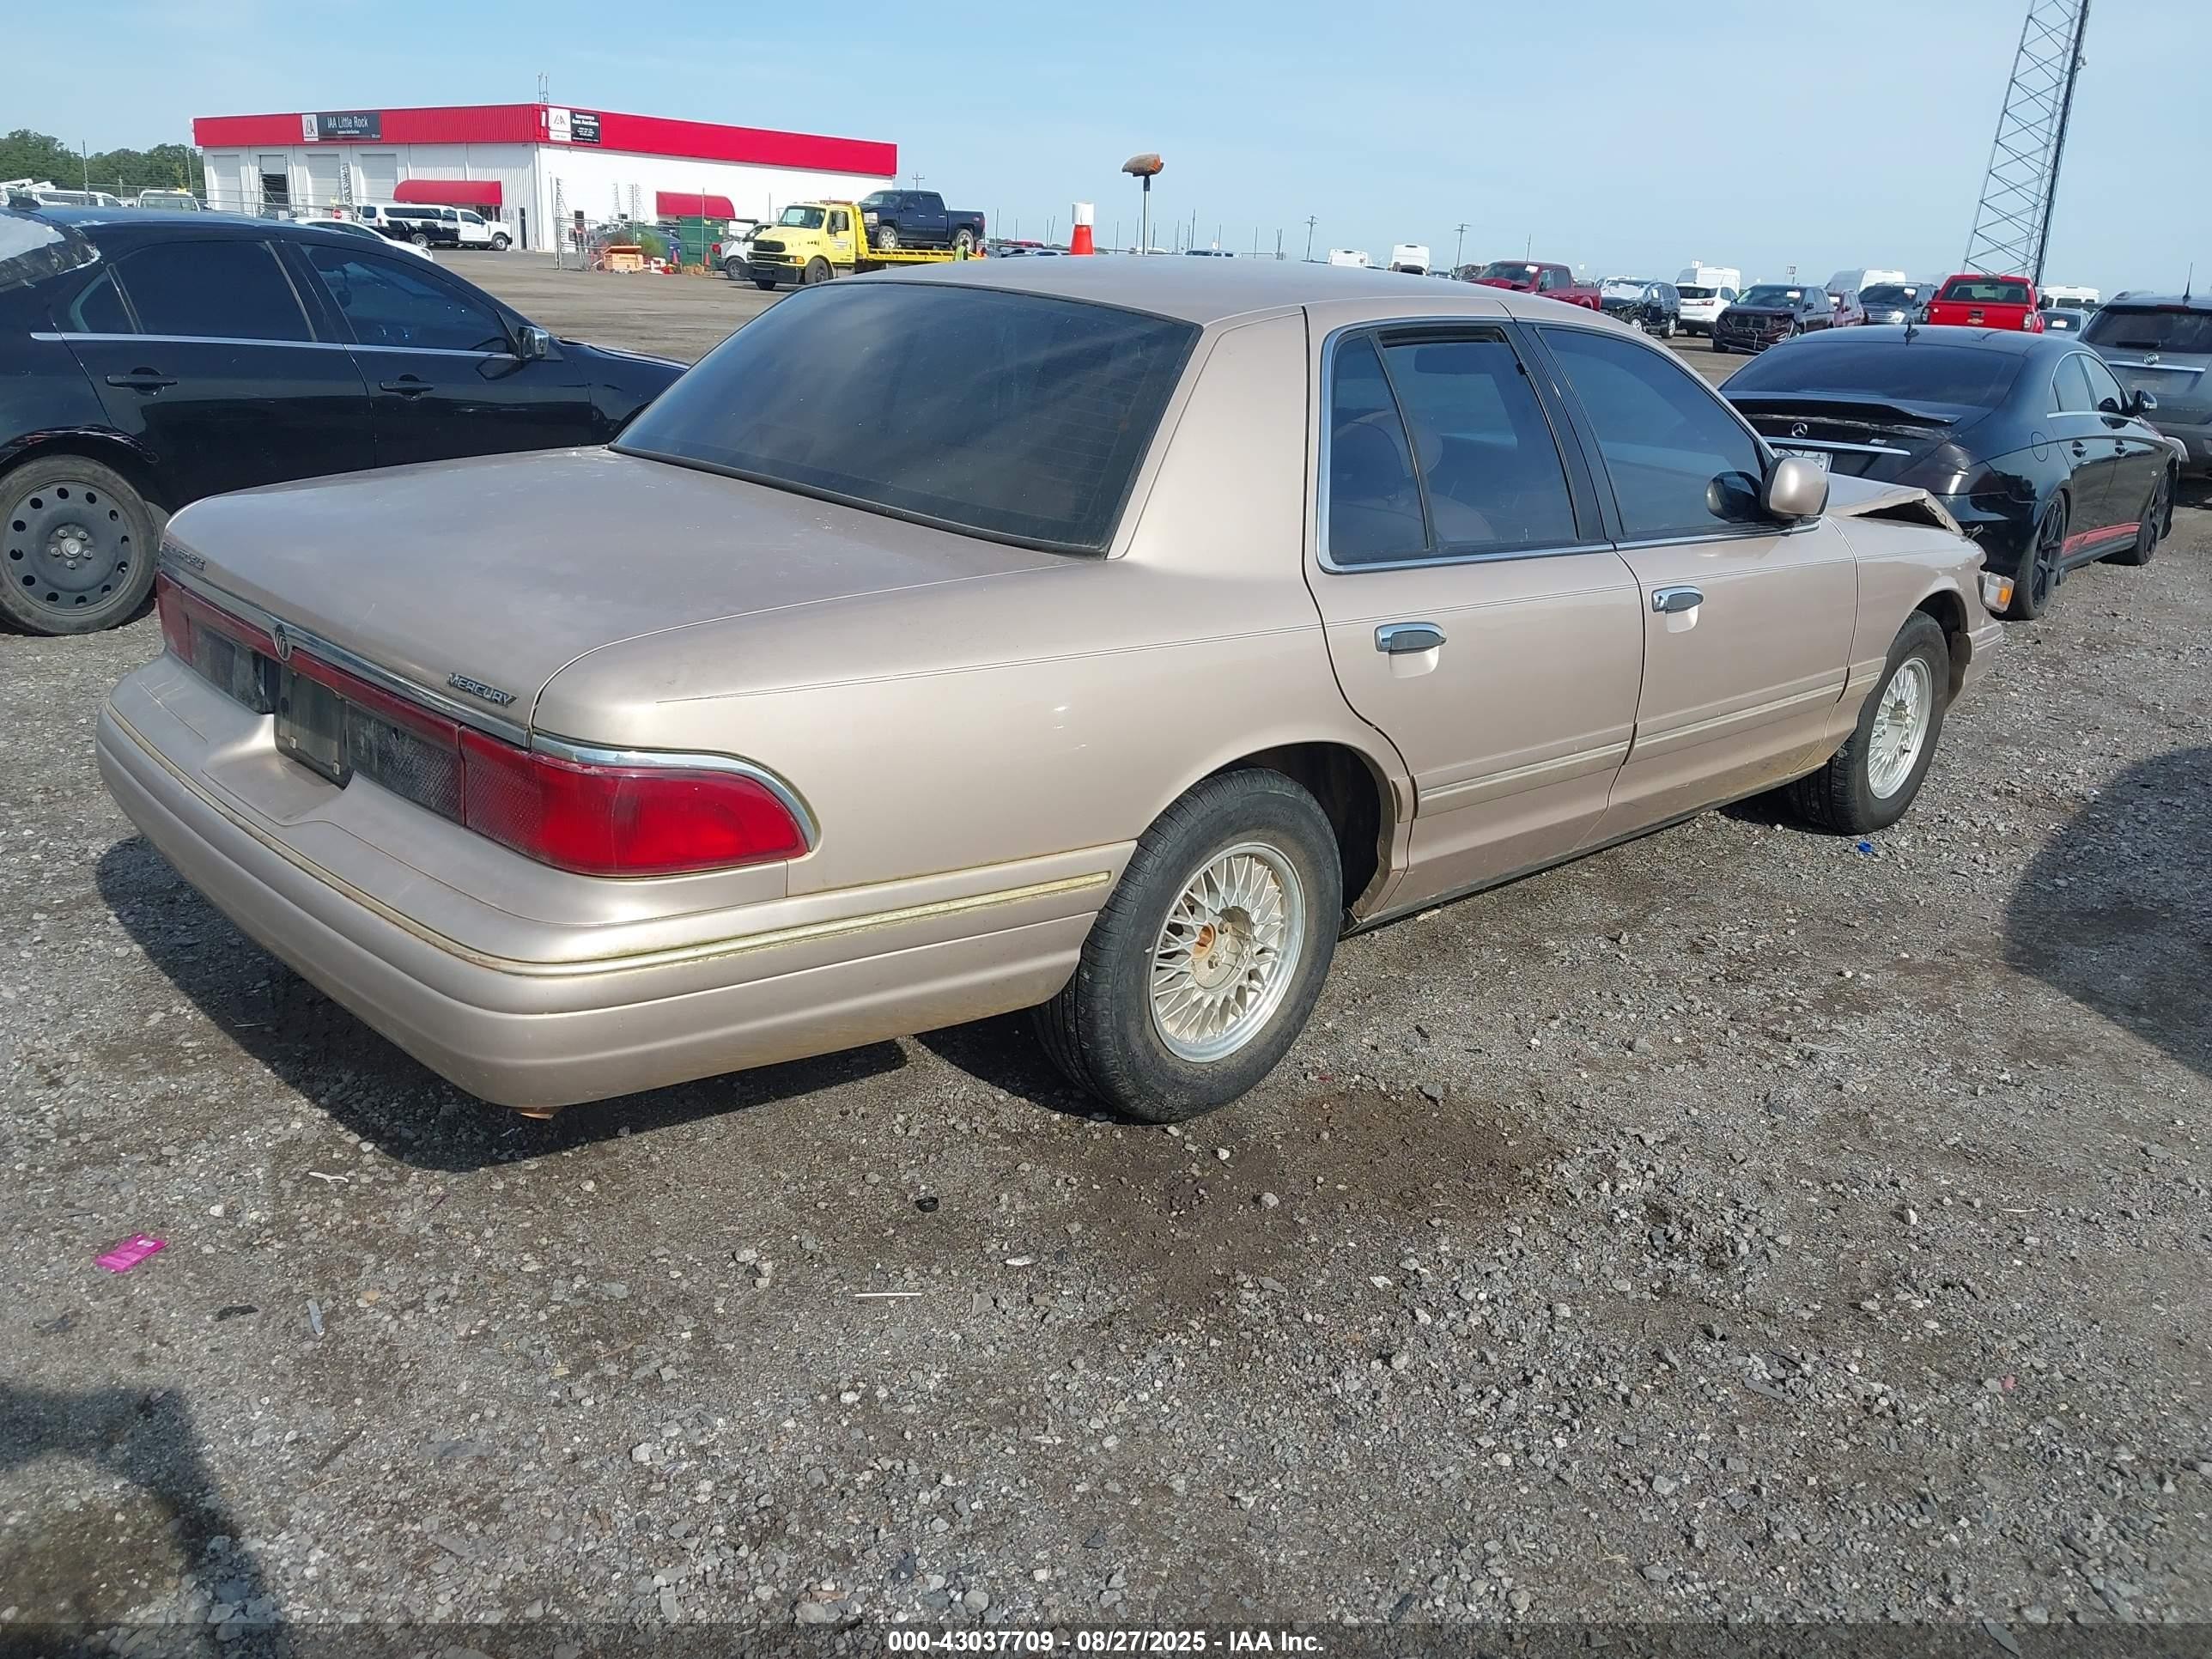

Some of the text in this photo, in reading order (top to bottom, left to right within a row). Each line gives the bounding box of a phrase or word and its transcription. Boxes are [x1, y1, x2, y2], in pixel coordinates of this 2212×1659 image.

[327, 115, 368, 128] IAA Little Rock
[447, 672, 517, 708] MERCURY
